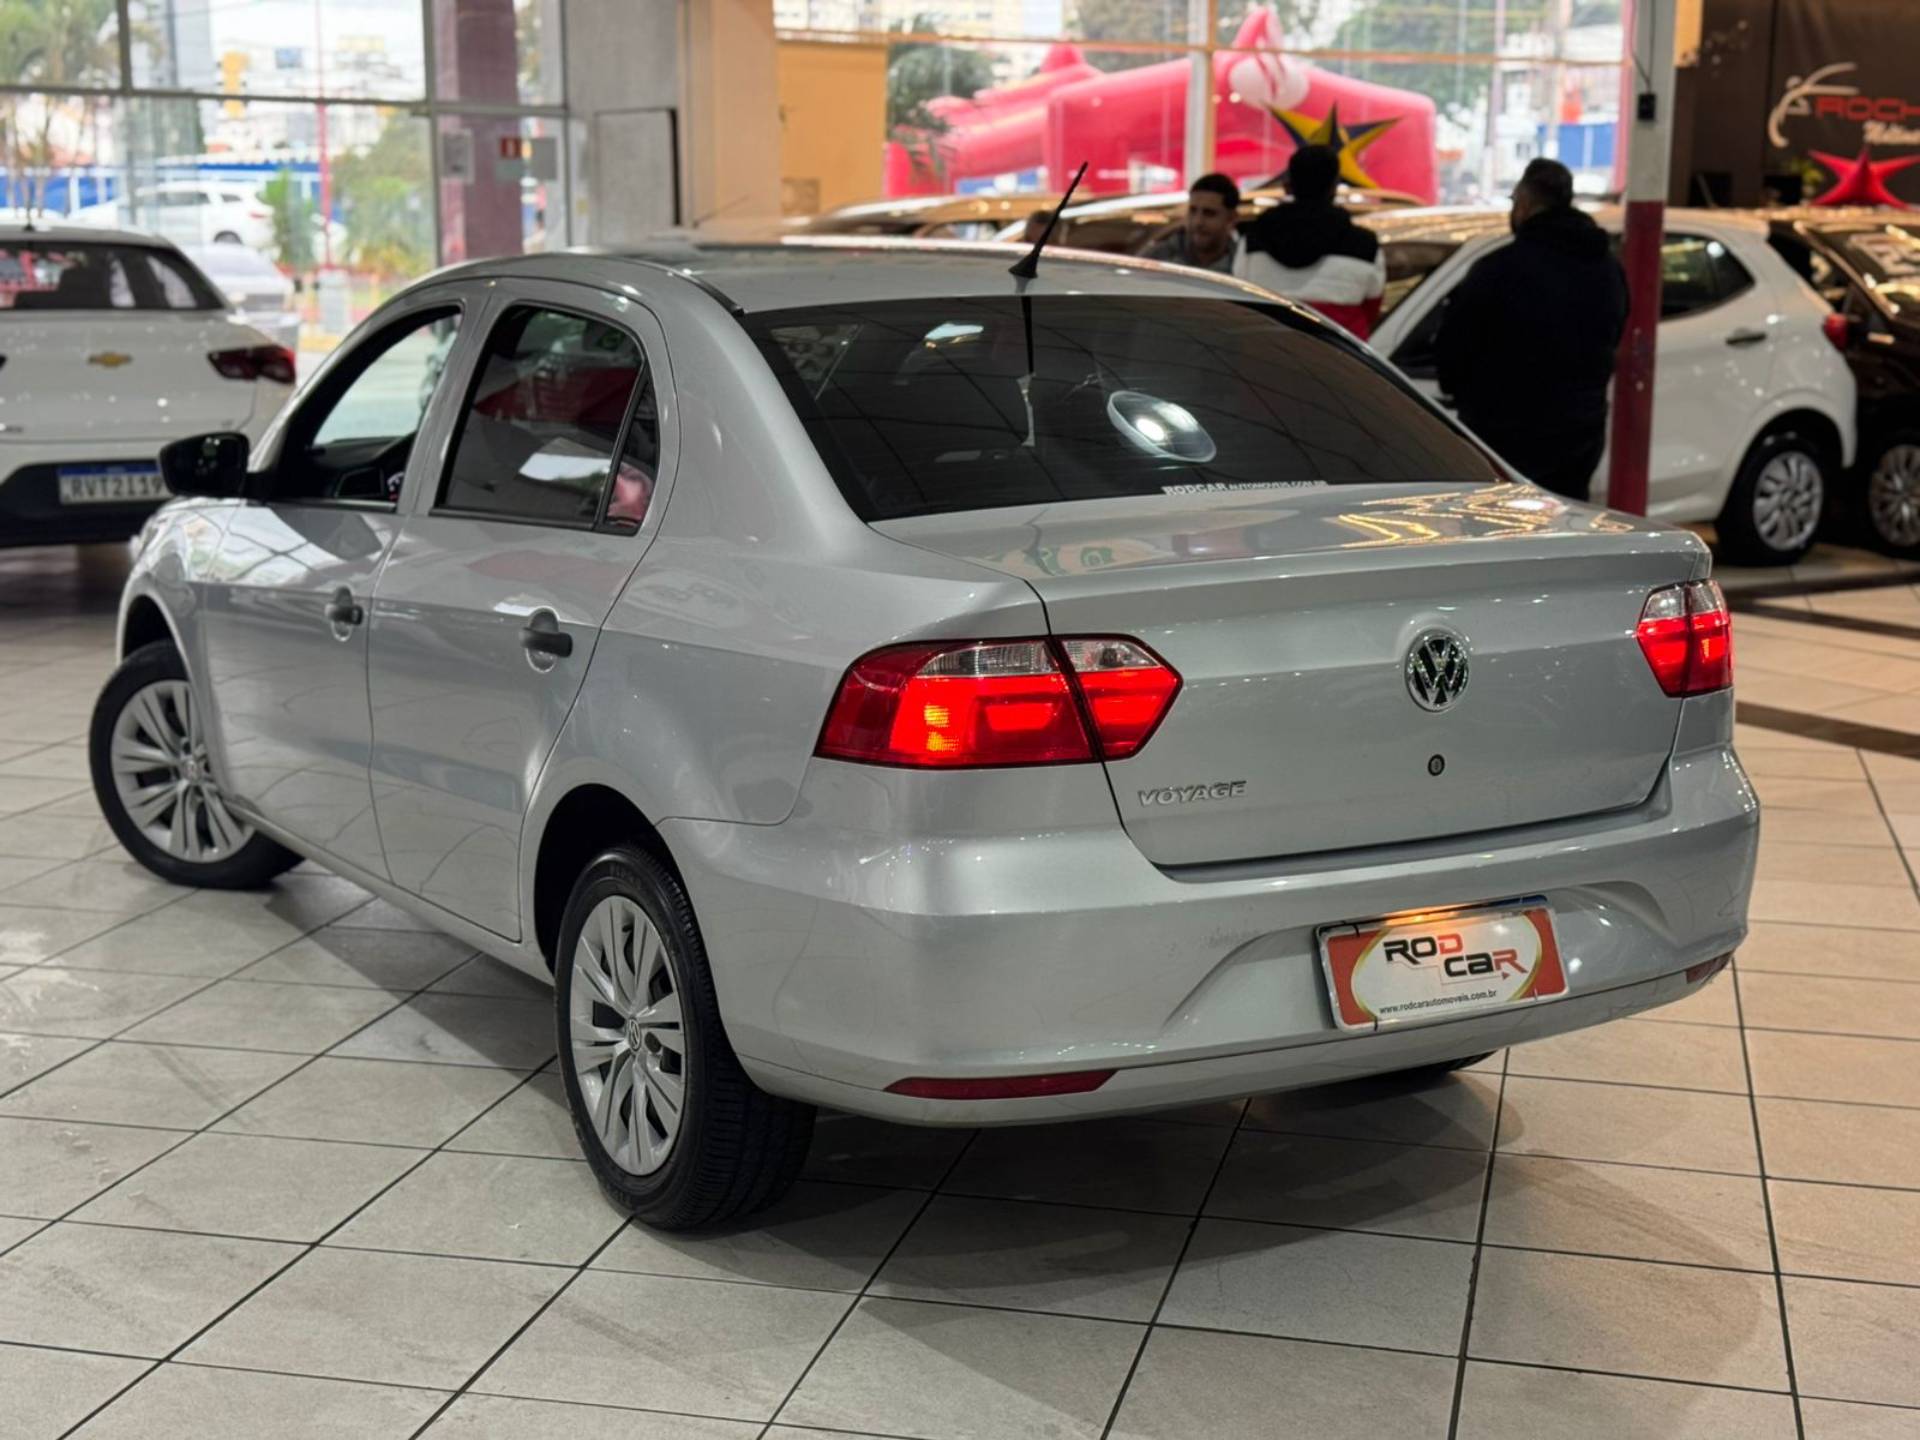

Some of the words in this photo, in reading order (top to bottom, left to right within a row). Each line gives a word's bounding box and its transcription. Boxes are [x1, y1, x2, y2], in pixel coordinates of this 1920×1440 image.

[1161, 482, 1227, 496] RODCAR
[1138, 780, 1247, 807] VOYAGE
[1383, 933, 1463, 965] ROD
[1379, 989, 1497, 1014] www.rodcarautomoveis.com.br
